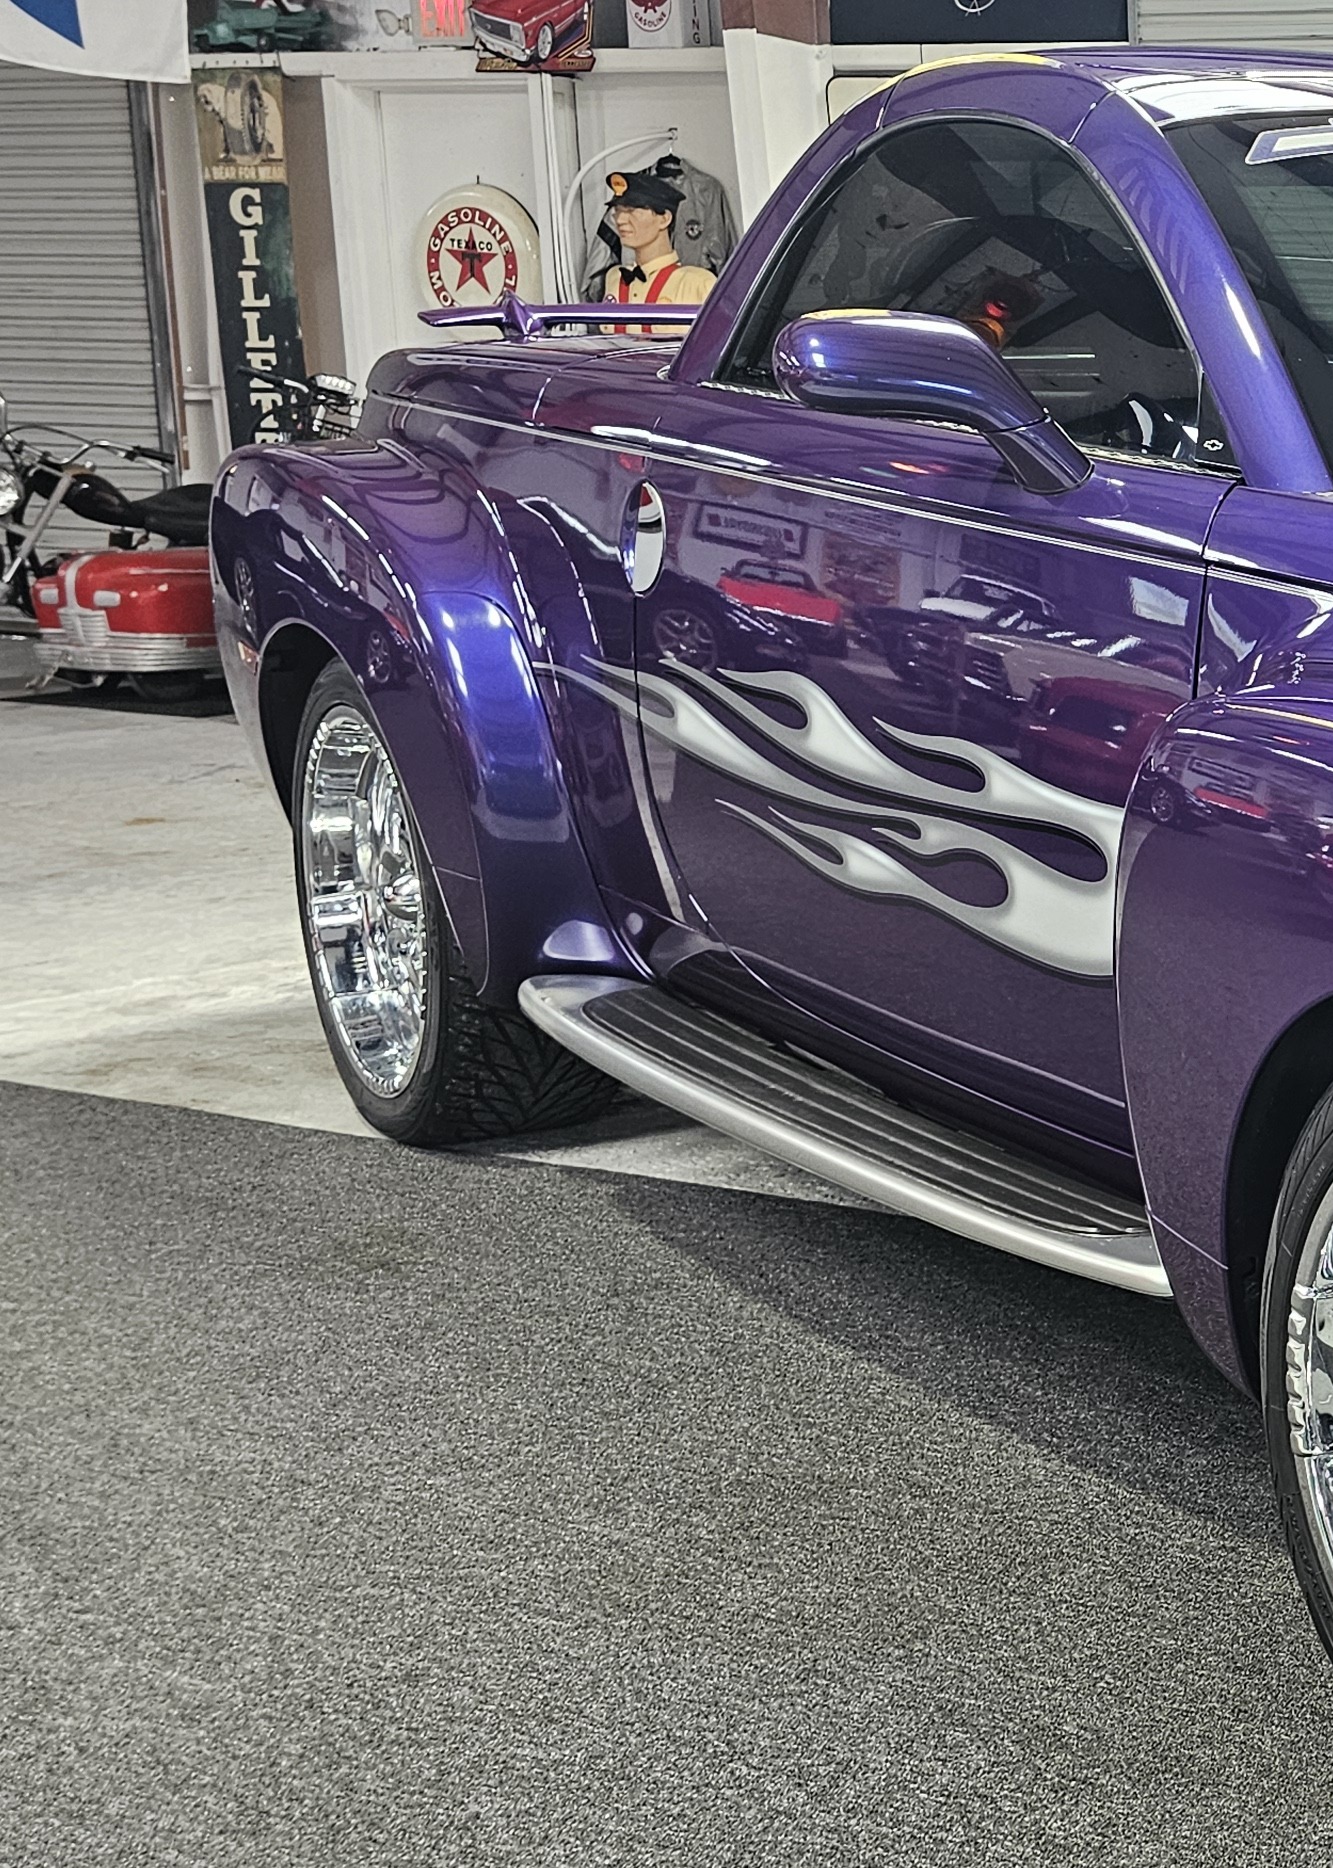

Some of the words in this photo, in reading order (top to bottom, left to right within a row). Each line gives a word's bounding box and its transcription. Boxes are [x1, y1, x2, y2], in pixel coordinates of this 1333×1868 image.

[691, 0, 701, 44] ING
[429, 208, 513, 256] GASOLINE
[449, 238, 493, 252] TEXACO
